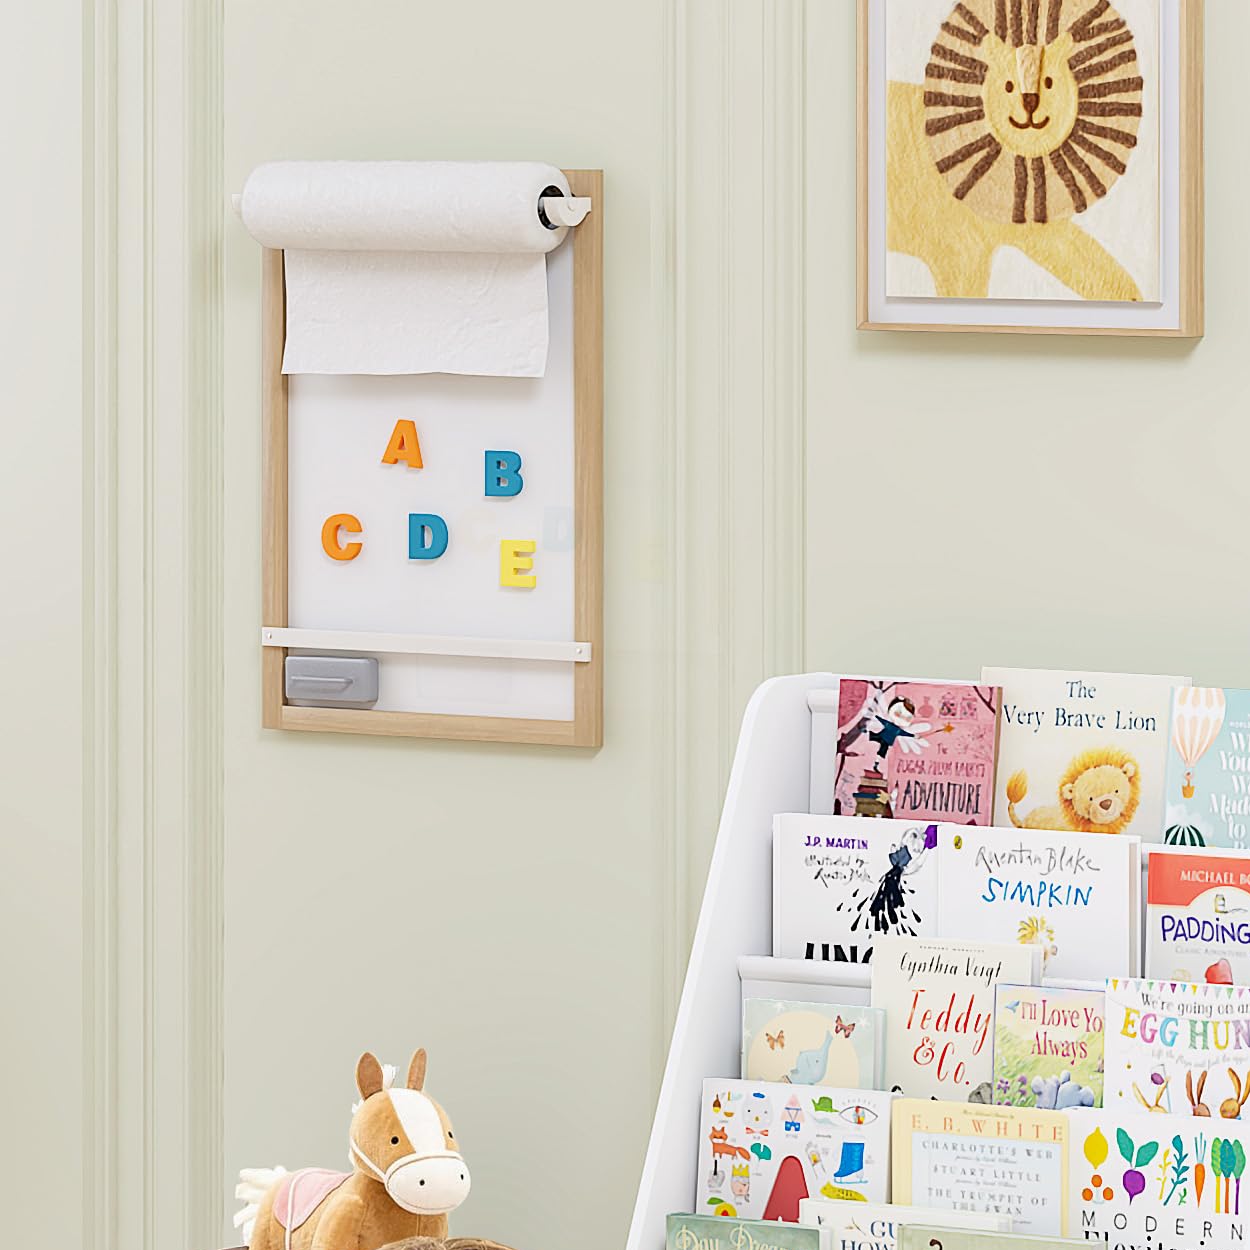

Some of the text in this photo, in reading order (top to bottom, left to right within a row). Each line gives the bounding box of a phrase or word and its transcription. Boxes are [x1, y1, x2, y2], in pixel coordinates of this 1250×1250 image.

[381, 418, 424, 469] A
[484, 449, 523, 497] B
[321, 513, 363, 561] C
[408, 513, 449, 560] D
[501, 539, 536, 589] E
[1066, 680, 1097, 699] The
[1004, 705, 1156, 733] Very Brave Lion
[900, 779, 982, 815] ADVENTURE
[826, 837, 868, 850] MARTIN
[1039, 846, 1101, 875] Blake
[981, 877, 1093, 908] SIMPKIN
[1180, 870, 1235, 885] MICHAEL
[900, 951, 959, 981] Cynthia
[1040, 1000, 1080, 1028] Love
[1141, 991, 1171, 1011] We're
[1177, 1001, 1213, 1018] going
[1217, 1004, 1234, 1015] on
[906, 988, 992, 1056] Teddy
[1120, 1006, 1179, 1047] EGG
[1031, 1031, 1088, 1066] Always
[971, 1118, 1064, 1142] WHITE
[922, 1139, 1017, 1156] CHARLOTTE'S
[933, 1164, 985, 1178] STUART
[993, 1169, 1041, 1183] LITTLE
[927, 1187, 953, 1199] THE
[1081, 1209, 1244, 1241] MODERN
